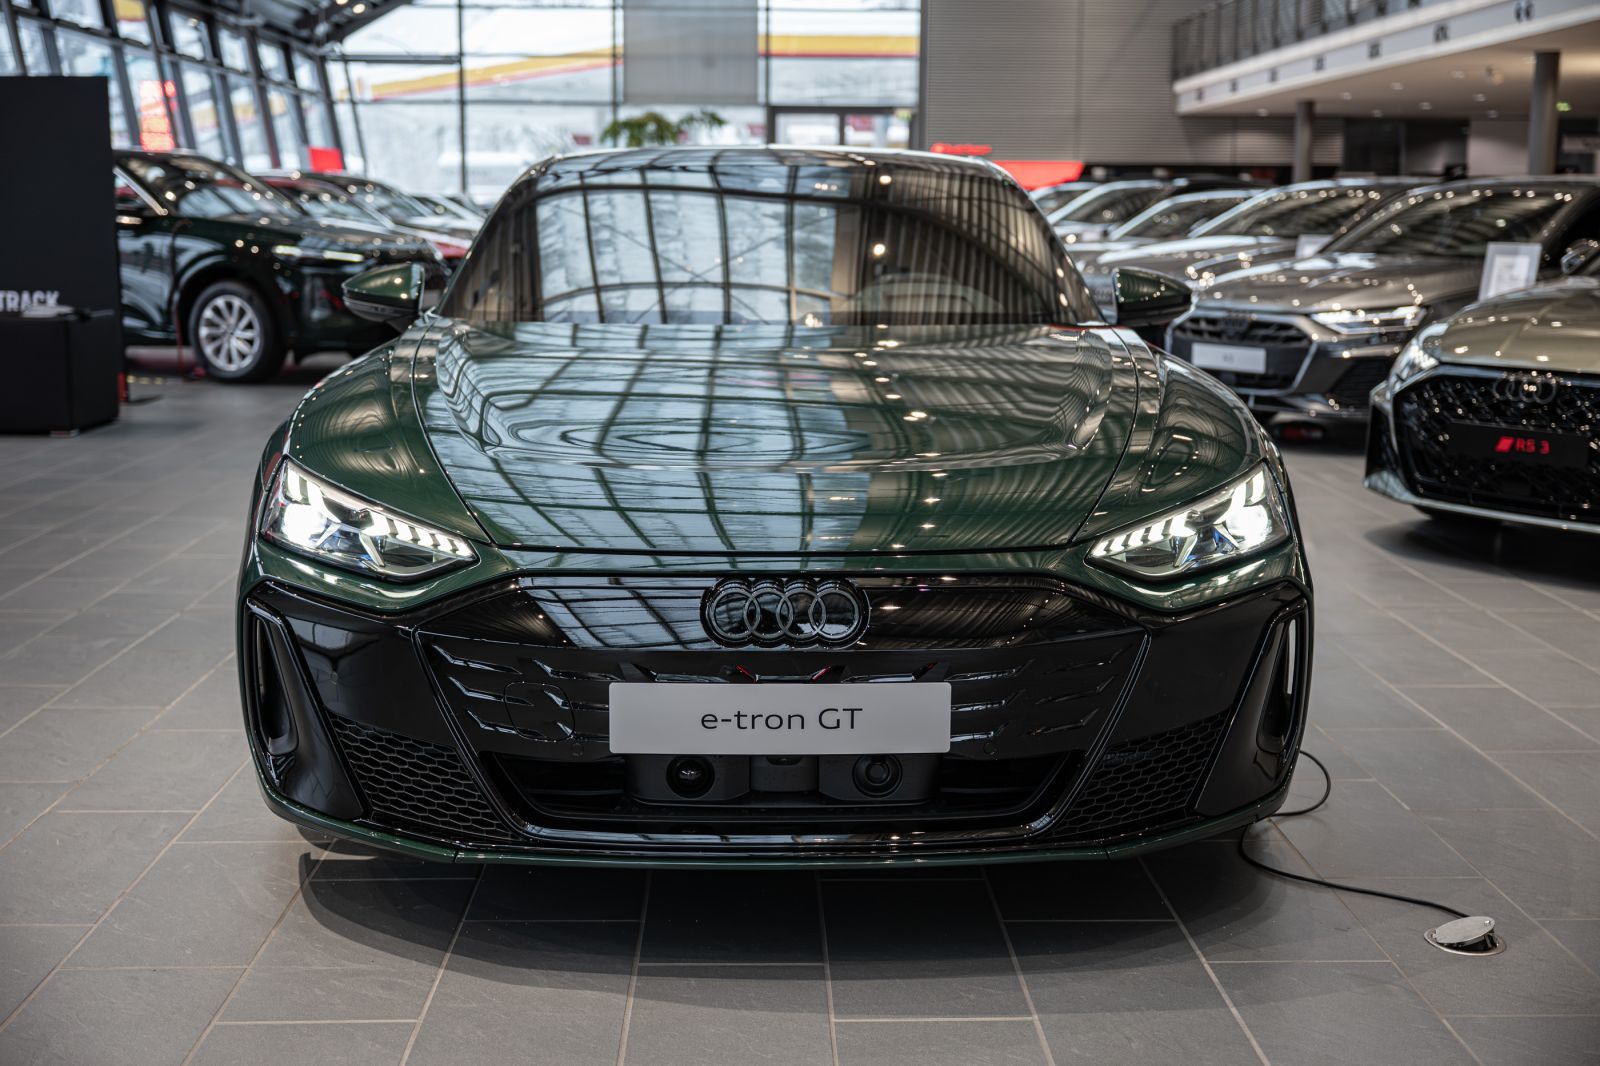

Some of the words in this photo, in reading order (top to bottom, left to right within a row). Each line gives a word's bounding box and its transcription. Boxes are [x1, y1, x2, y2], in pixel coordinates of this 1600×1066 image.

[1515, 438, 1536, 453] RS
[1540, 440, 1550, 454] 3
[701, 710, 805, 730] e-tron
[818, 708, 863, 730] GT
